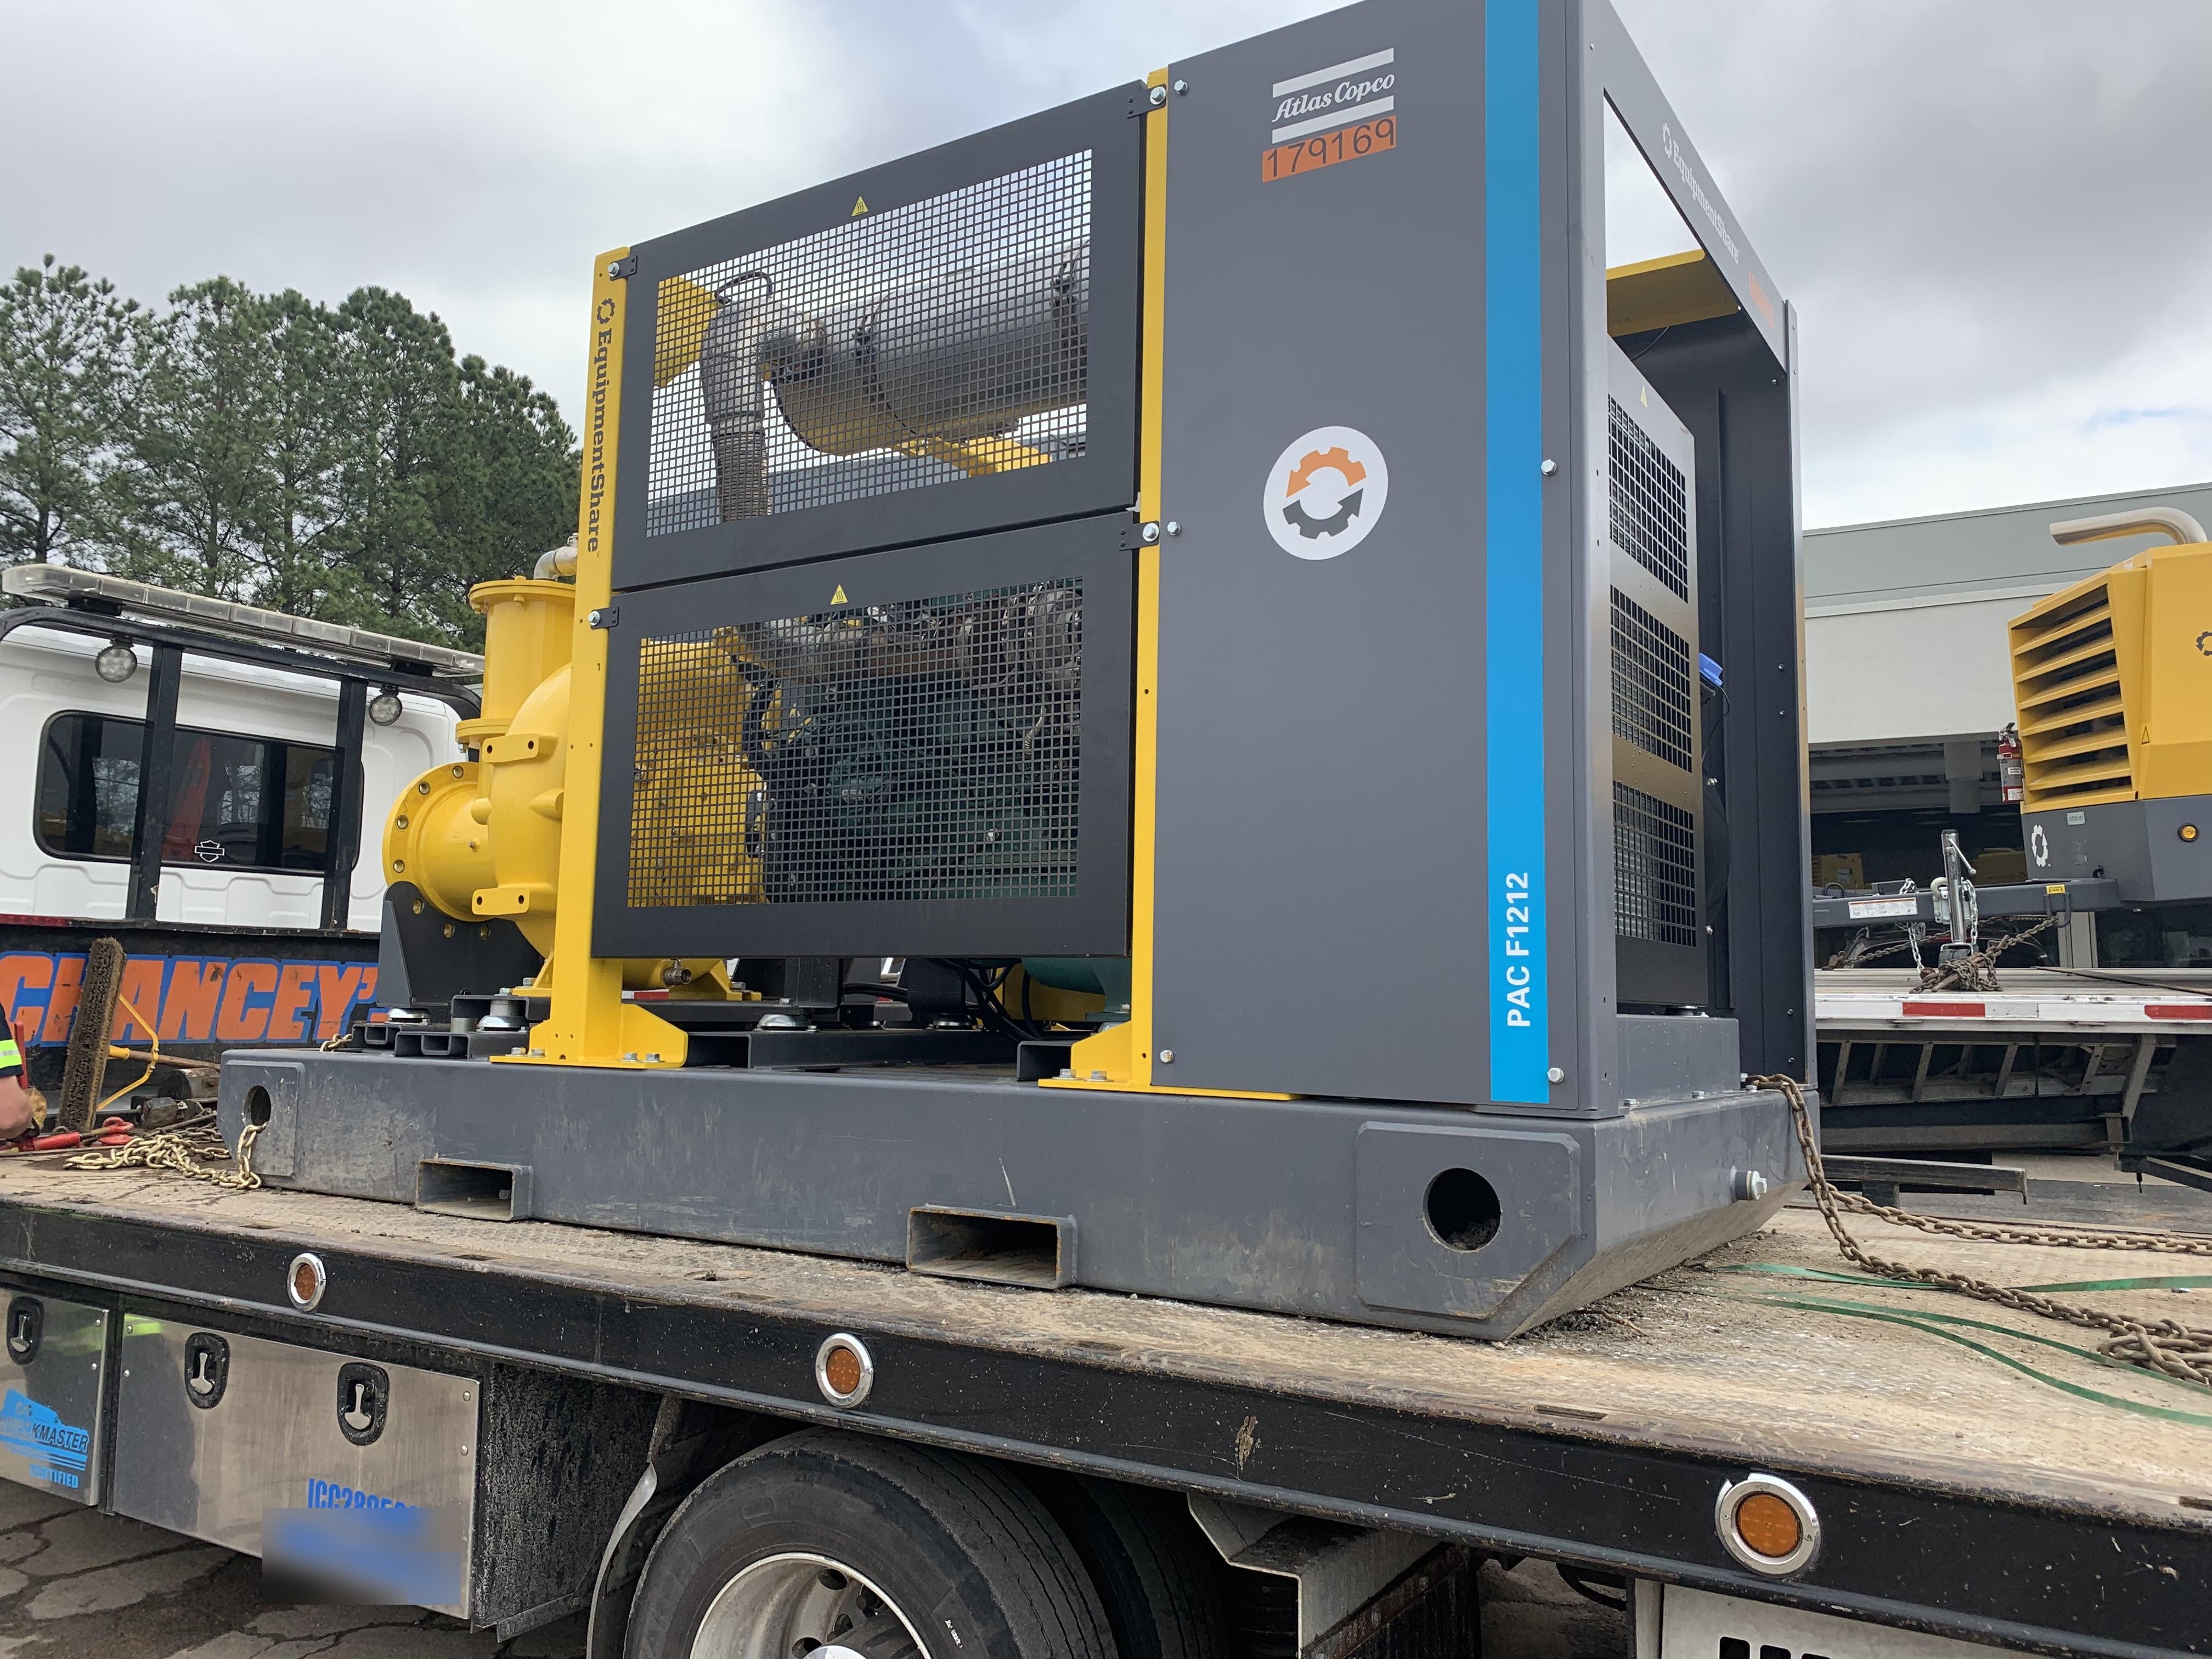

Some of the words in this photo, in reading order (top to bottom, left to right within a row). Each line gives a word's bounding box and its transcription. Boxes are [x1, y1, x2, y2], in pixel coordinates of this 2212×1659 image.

[1272, 92, 1332, 122] Atlas
[1334, 74, 1395, 103] Copco
[1266, 117, 1394, 178] 179169
[1673, 139, 1740, 264] EquipmentShare
[587, 328, 612, 552] EquipmentShare
[1505, 872, 1530, 956] F1212
[0, 955, 388, 1041] CHANCEY'
[1506, 966, 1531, 1027] PAC
